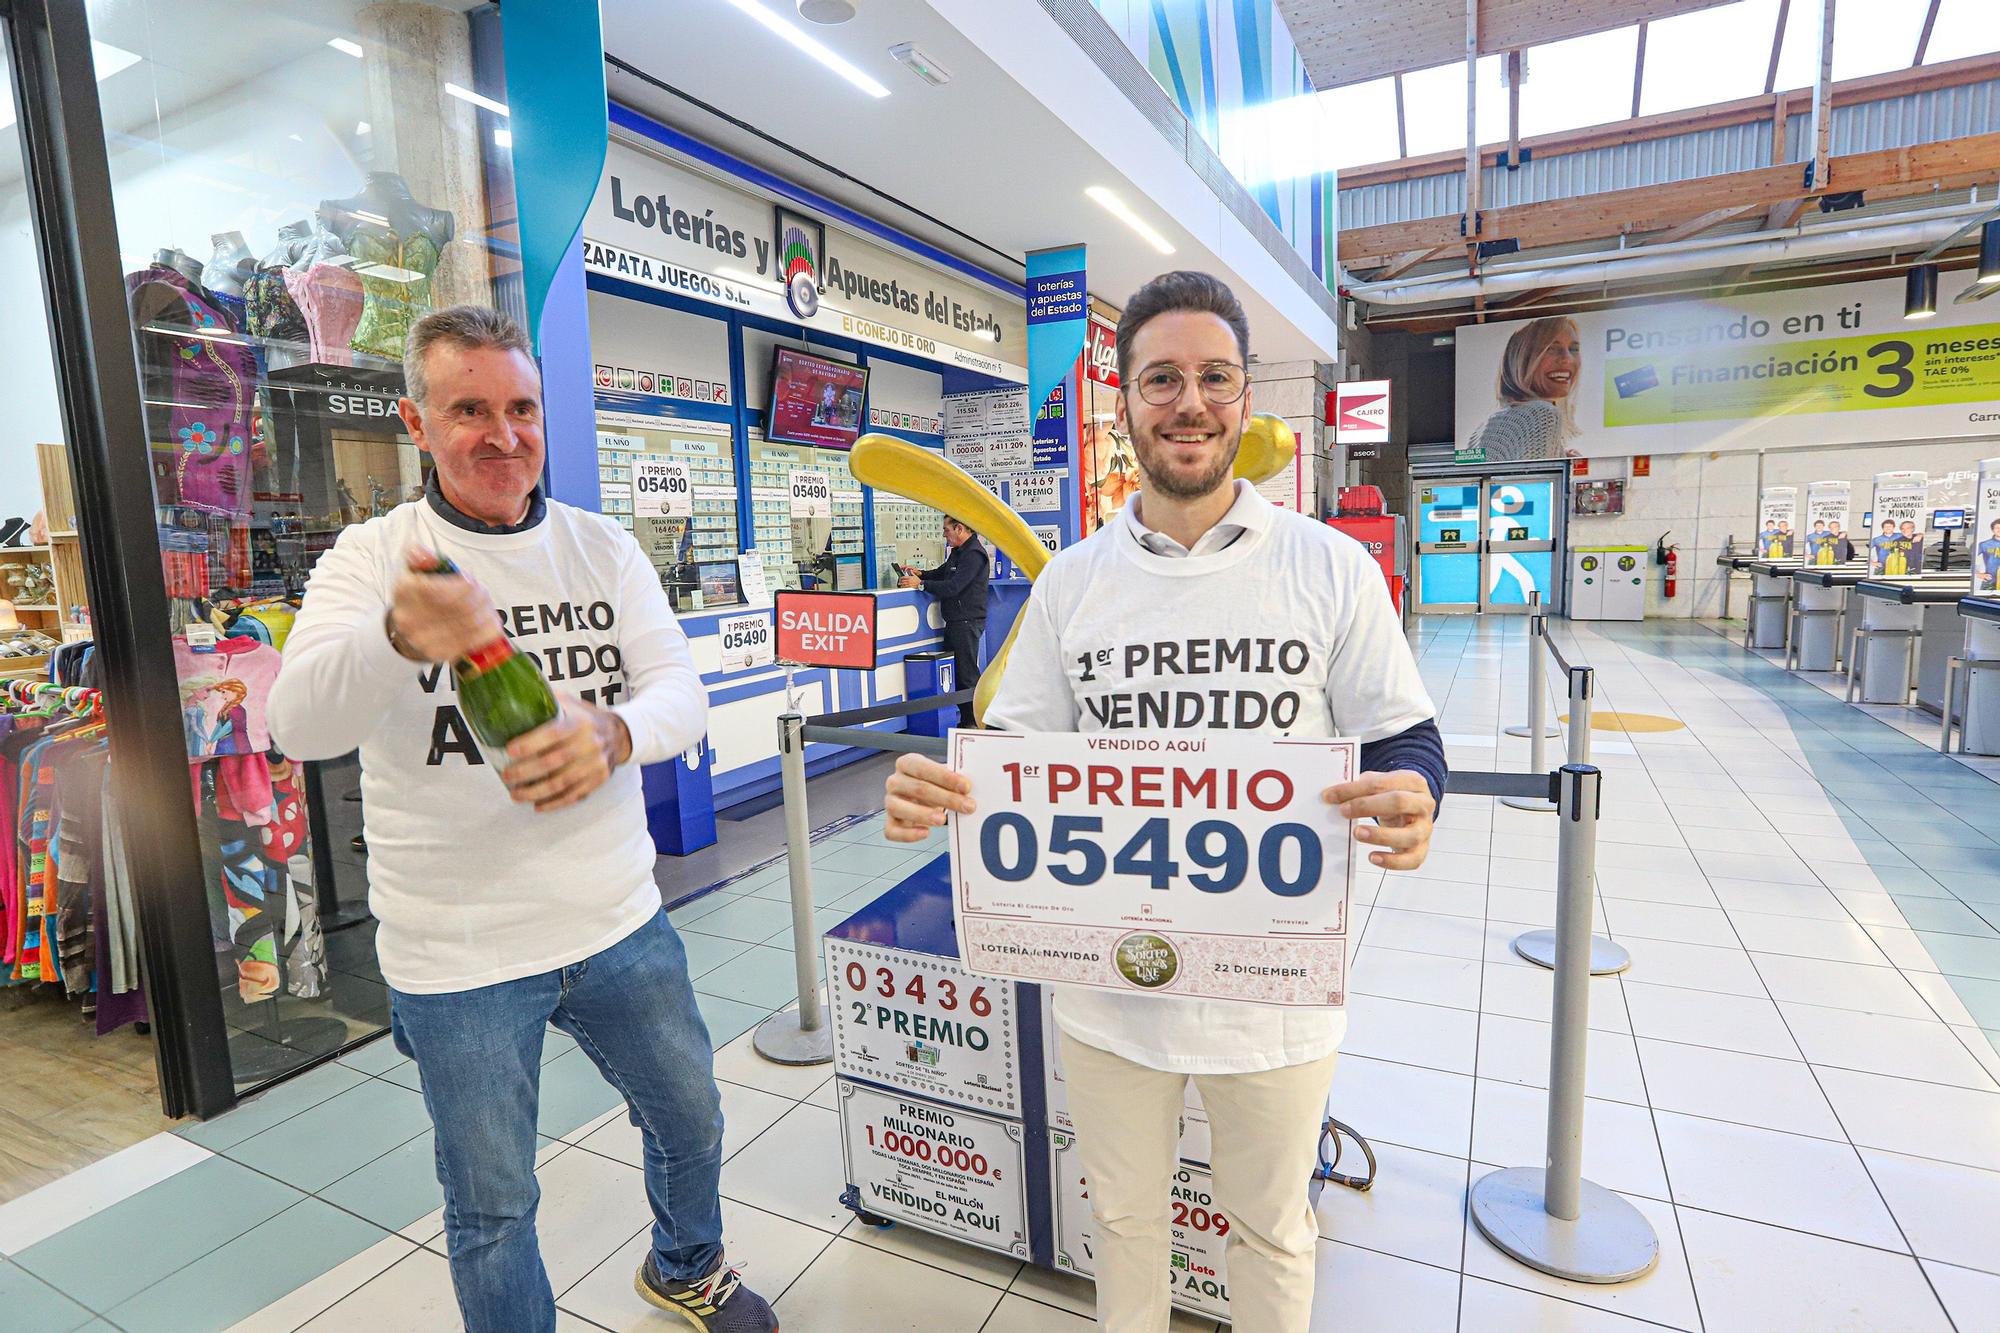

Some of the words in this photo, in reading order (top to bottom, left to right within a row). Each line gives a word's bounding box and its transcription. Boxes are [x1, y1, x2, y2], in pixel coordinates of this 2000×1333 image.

[611, 176, 747, 258] Loterías
[754, 237, 769, 275] y
[584, 242, 653, 280] ZAPATA
[658, 264, 721, 298] JUEGOS
[725, 285, 750, 305] S.L.
[1037, 279, 1074, 292] loterías
[827, 256, 919, 316] Apuestas
[925, 291, 949, 325] del
[953, 303, 1002, 343] Estado
[1030, 297, 1037, 307] y
[1037, 291, 1082, 306] apuestas
[1030, 306, 1046, 317] del
[1047, 303, 1082, 316] Estado
[1605, 315, 1770, 352] Pensando
[1783, 313, 1824, 335] en
[1837, 303, 1862, 329] ti
[856, 321, 899, 345] CONEJO
[901, 332, 915, 349] DE
[917, 339, 936, 355] ORO
[1925, 338, 2000, 356] meses
[954, 351, 993, 371] Administración
[1671, 349, 1858, 386] Financiación
[1863, 340, 1915, 398] 3
[1925, 358, 1942, 366] sin
[1923, 367, 1948, 377] TAE
[1950, 365, 1970, 375] 0%
[326, 381, 400, 396] PROFES
[328, 394, 399, 417] SEBA
[1356, 408, 1385, 416] CAJERO
[613, 437, 630, 447] NIÑO
[691, 443, 706, 451] NIÑO
[648, 466, 682, 476] PREMIO
[800, 475, 824, 484] PREMIO
[637, 476, 687, 493] 05490
[793, 484, 827, 499] 05490
[1023, 488, 1054, 496] PREMIO
[1888, 509, 1916, 519] MUNDO
[497, 601, 615, 637] REMIO
[734, 619, 764, 632] PREMIO
[781, 610, 870, 634] SALIDA
[724, 628, 767, 649] 05490
[801, 633, 848, 652] EXIT
[1125, 638, 1310, 678] PREMIO
[1085, 690, 1301, 729] VENDIDO
[1087, 738, 1159, 752] VENDIDO
[1164, 738, 1206, 753] AQUÍ
[1003, 762, 1040, 802] 1er
[1047, 764, 1294, 812] PREMIO
[979, 811, 1323, 897] 05490
[981, 943, 1029, 955] LOTERÍA
[1043, 949, 1100, 962] NAVIDAD
[1214, 963, 1229, 972] 22
[1234, 965, 1308, 977] DICIEMBRE
[876, 1005, 990, 1052] PREMIO
[895, 1061, 914, 1069] SORTEO
[981, 1082, 1002, 1092] Nacional
[900, 1103, 955, 1128] PREMIO
[883, 1116, 975, 1150] MILLONARIO
[865, 1124, 988, 1176] 1.000.000
[992, 1168, 1002, 1181] €
[872, 1149, 887, 1159] TODAS
[932, 1166, 966, 1180] MILLONARIOS
[974, 1177, 995, 1188] ESPAÑA
[898, 1163, 912, 1171] TOCA
[945, 1175, 966, 1186] ESPAÑA
[870, 1181, 947, 1217] VENDIDO
[953, 1208, 1000, 1233] AQUÍ
[935, 1190, 947, 1200] EL
[948, 1193, 984, 1210] MILLÓN
[1190, 1262, 1215, 1277] Loto
